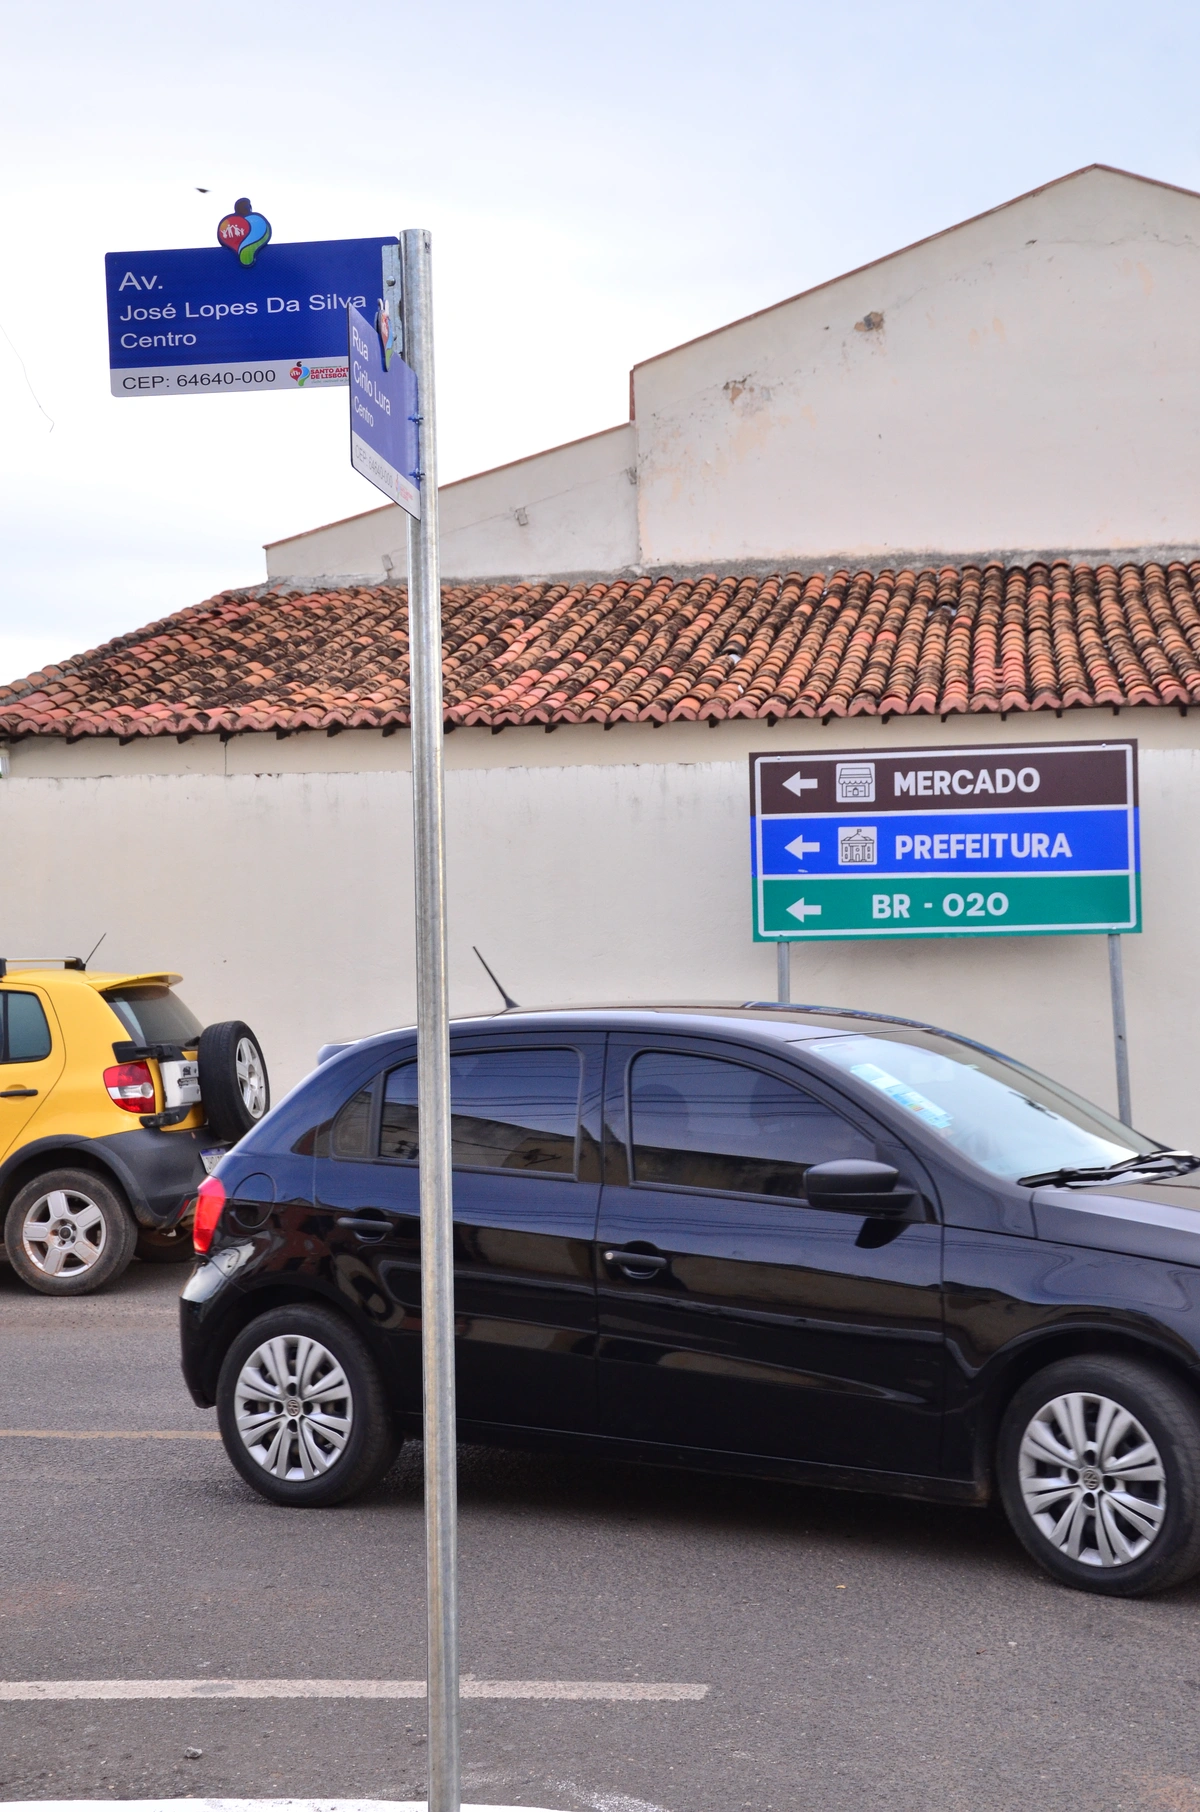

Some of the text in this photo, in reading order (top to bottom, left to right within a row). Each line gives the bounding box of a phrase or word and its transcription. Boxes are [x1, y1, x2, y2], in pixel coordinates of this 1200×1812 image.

[118, 271, 163, 292] Av.
[120, 293, 367, 321] José Lopes Da Silva
[120, 331, 197, 349] Centro
[352, 326, 369, 361] Rua
[122, 369, 277, 390] CEP: 64640-000
[353, 396, 374, 427] Centro
[374, 381, 391, 416] Lura
[893, 767, 1041, 797] MERCADO
[895, 832, 1073, 860] PREFEITURA
[872, 893, 911, 919] BR
[942, 891, 1009, 917] 020
